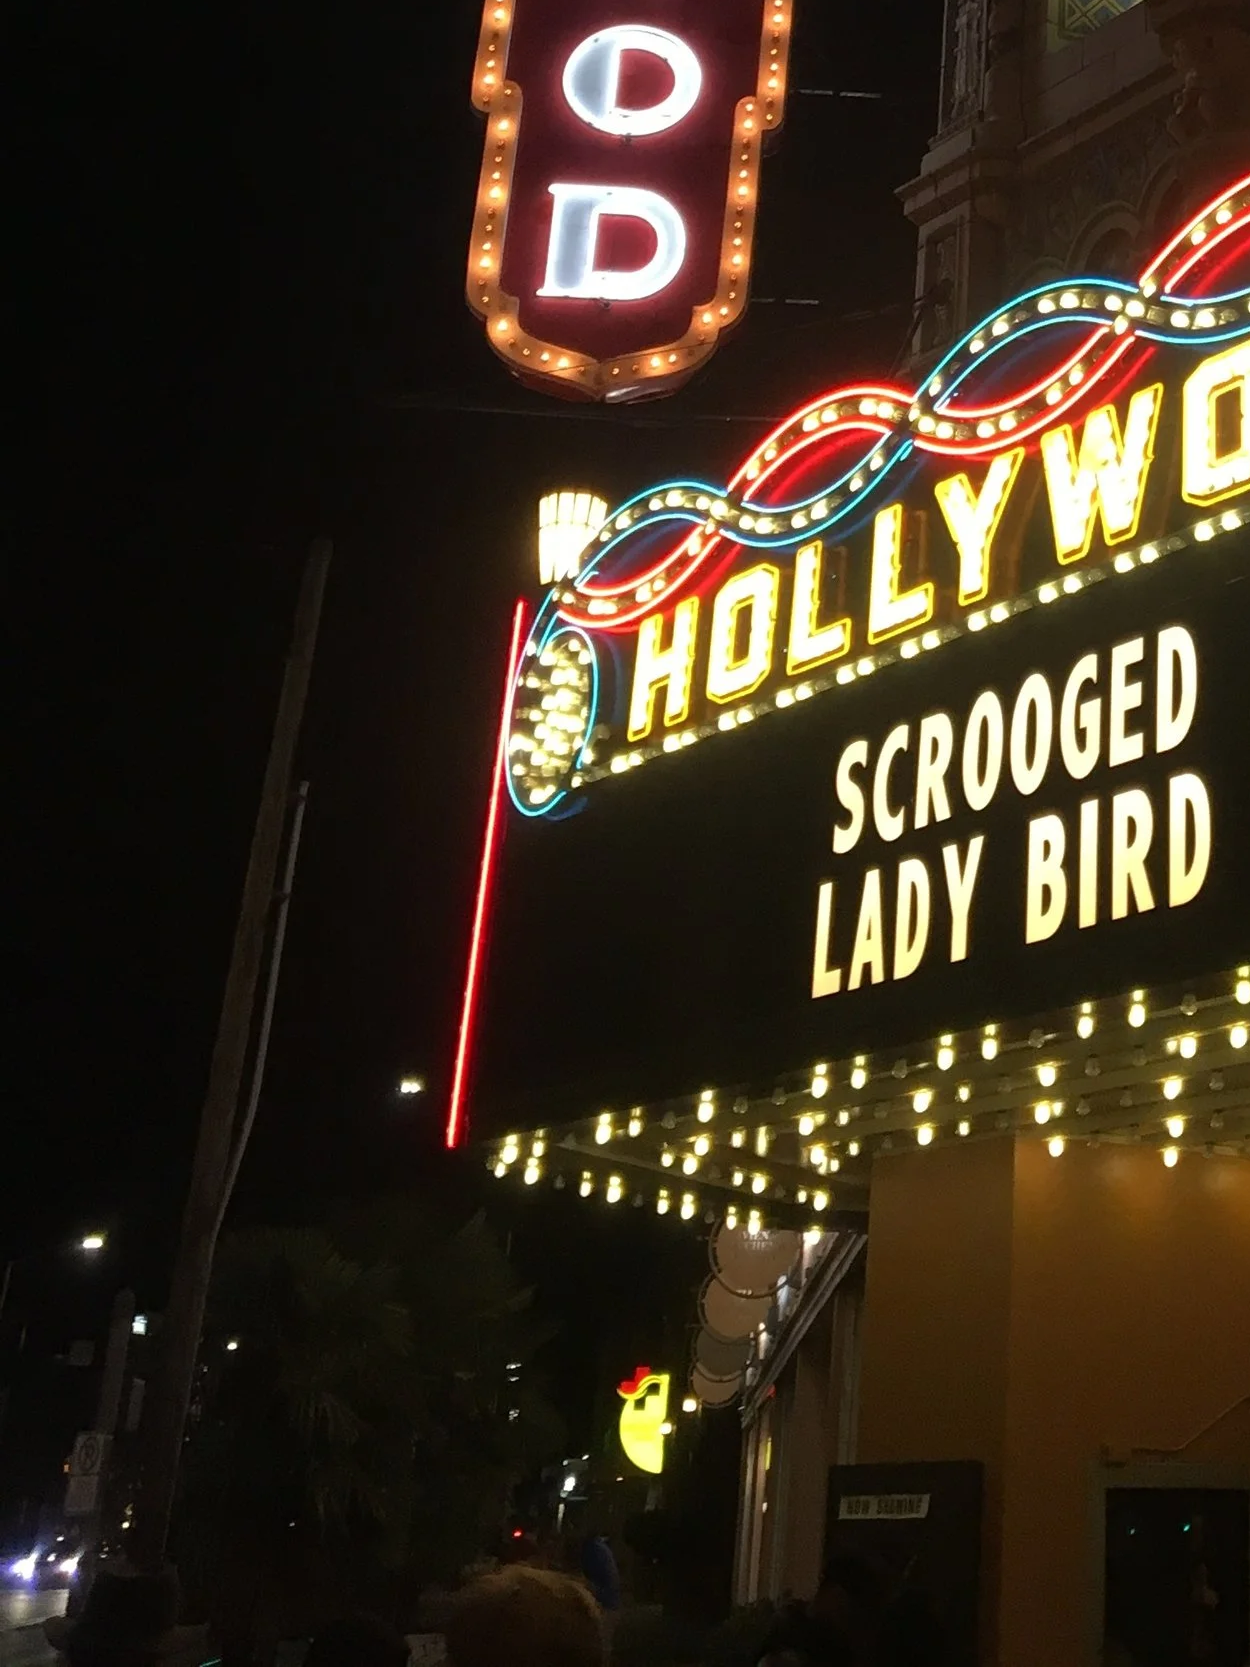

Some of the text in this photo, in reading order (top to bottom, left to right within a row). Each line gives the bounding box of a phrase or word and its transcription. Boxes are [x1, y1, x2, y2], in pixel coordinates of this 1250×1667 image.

[832, 626, 1198, 854] SCROOGED
[811, 772, 1212, 998] LADY BIRD
